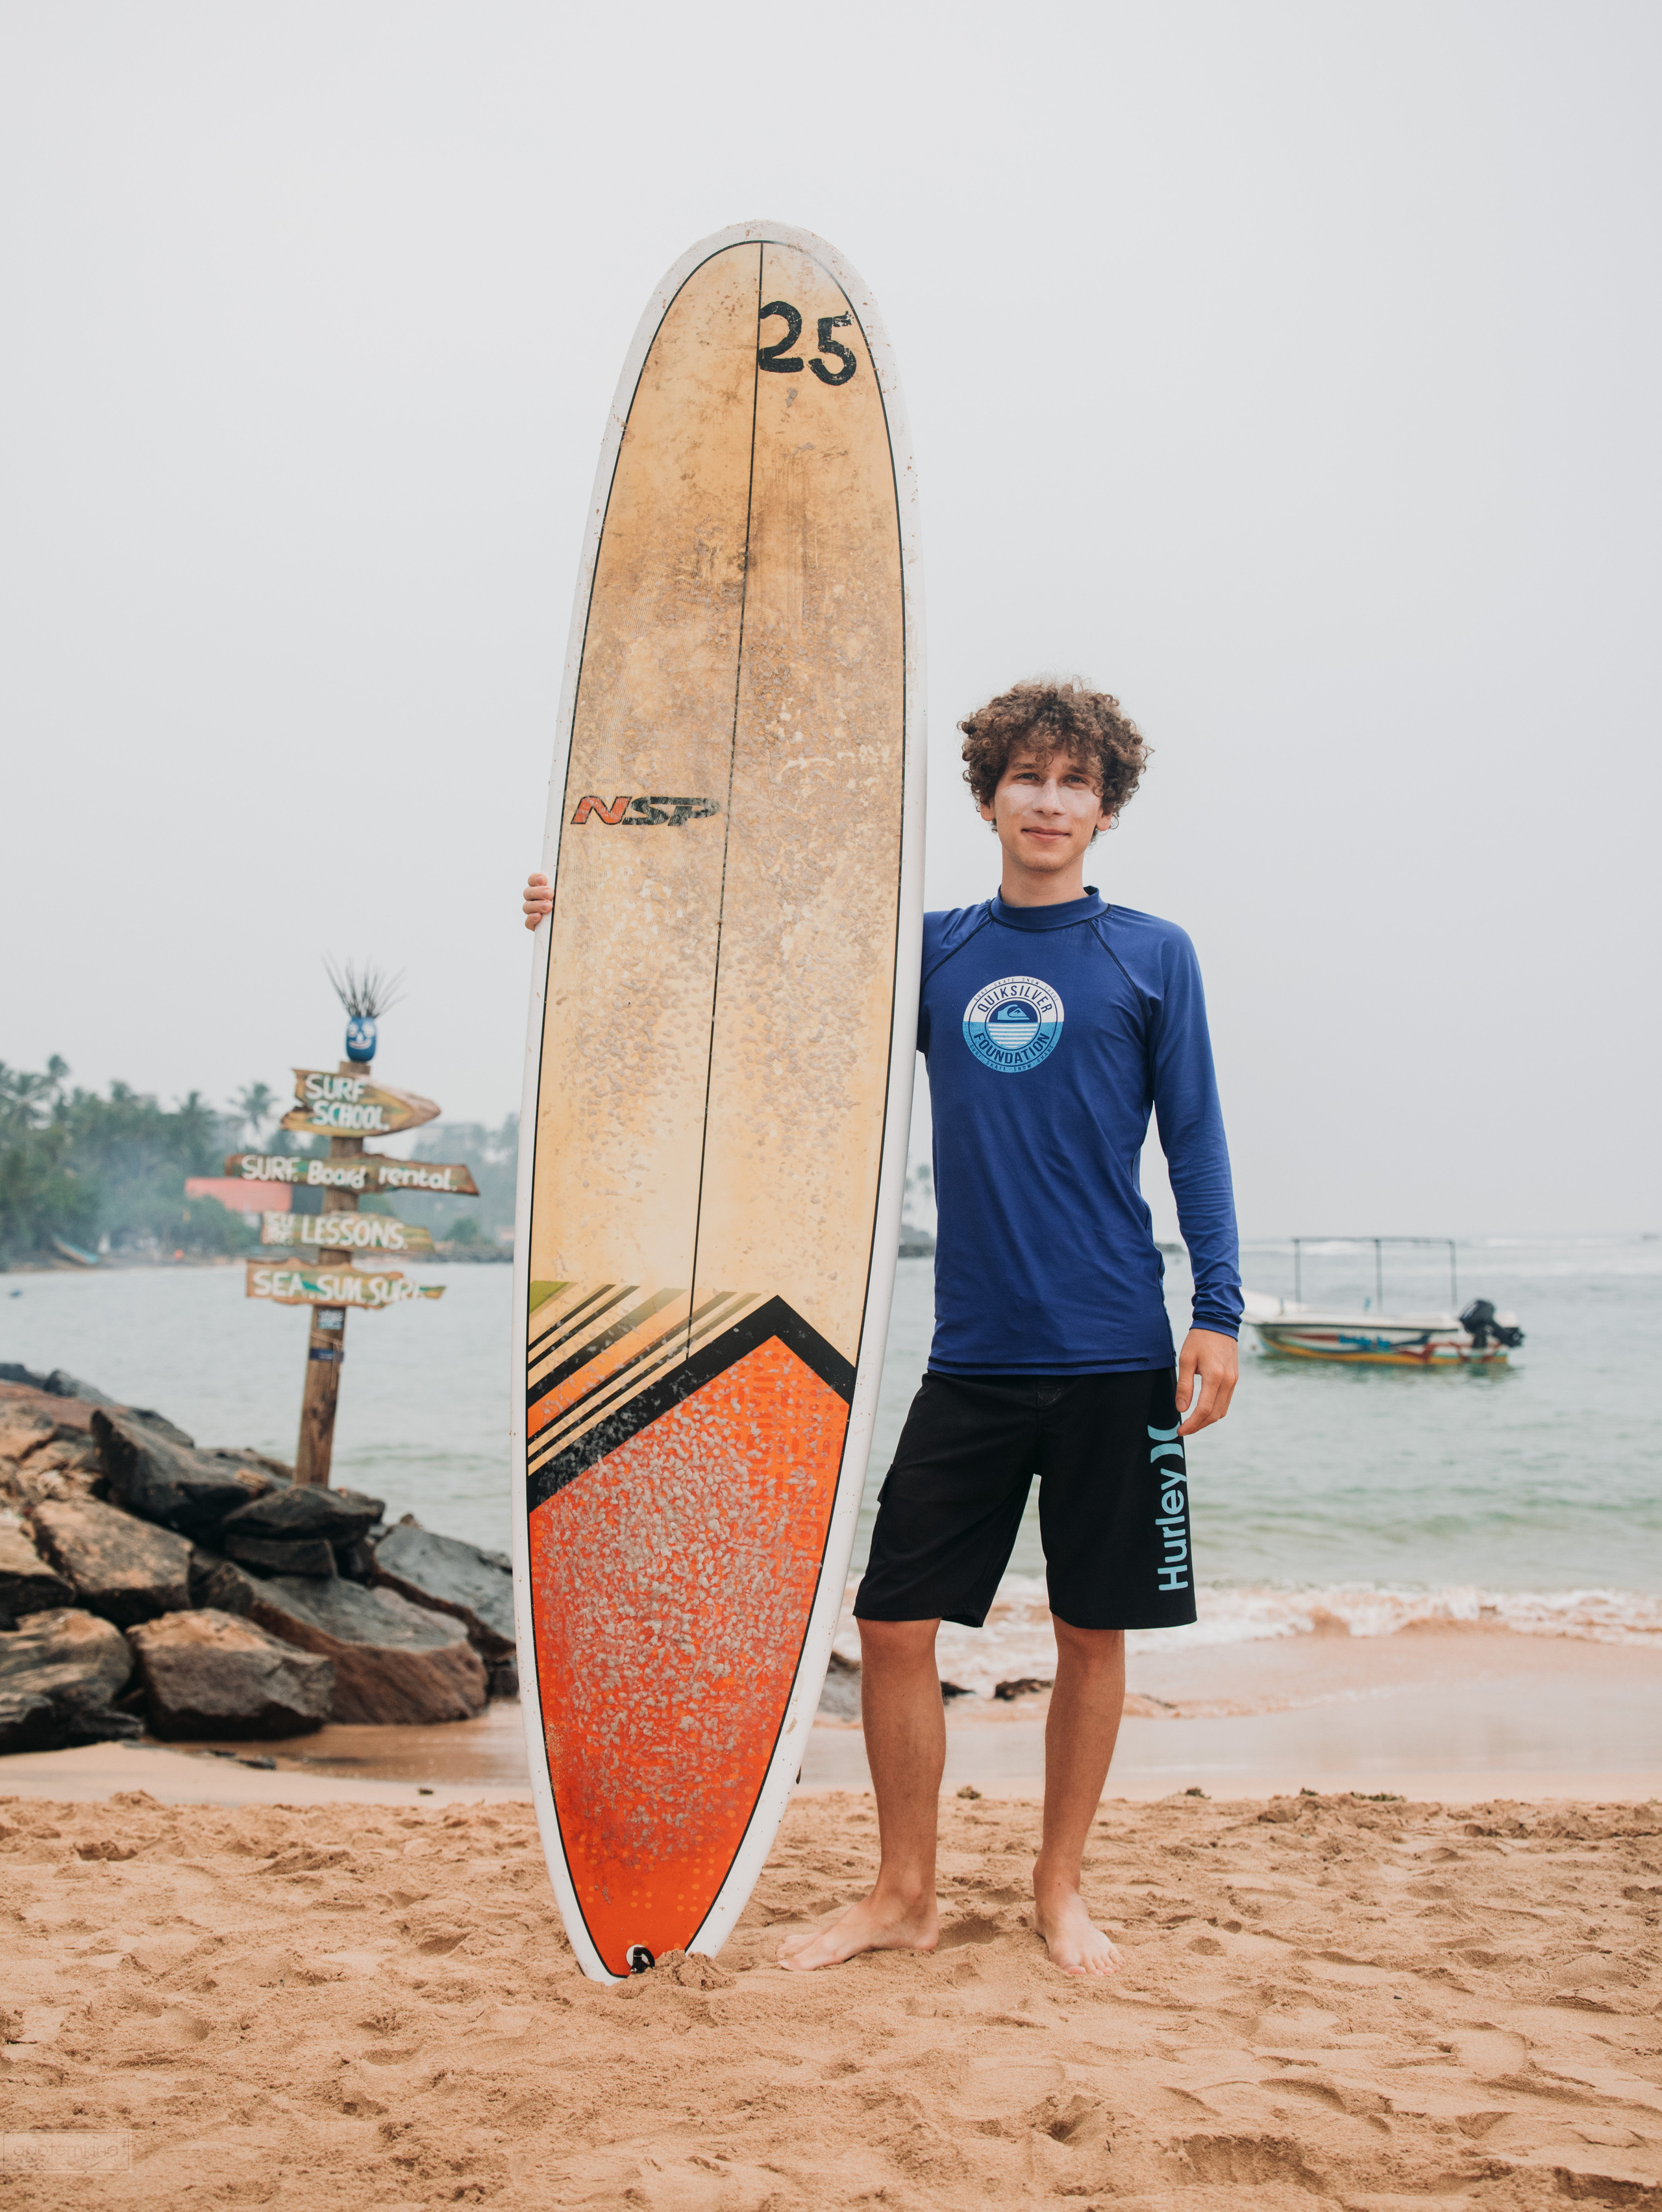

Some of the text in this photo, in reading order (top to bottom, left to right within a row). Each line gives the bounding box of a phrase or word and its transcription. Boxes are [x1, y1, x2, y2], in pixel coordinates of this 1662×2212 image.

[758, 301, 857, 386] 25
[570, 795, 721, 826] NSP
[974, 977, 1059, 1002] SURF SKATE SNOW SHARE
[977, 985, 1053, 1013] QUIKSILVER
[969, 1044, 1054, 1072] SURF SKATE SNOW SHARE
[973, 1032, 1050, 1064] FOUNDATION
[305, 1073, 366, 1102] SURF
[306, 1160, 366, 1189] Board
[301, 1214, 409, 1250] LESSONS.
[1155, 1467, 1189, 1591] Hurley
